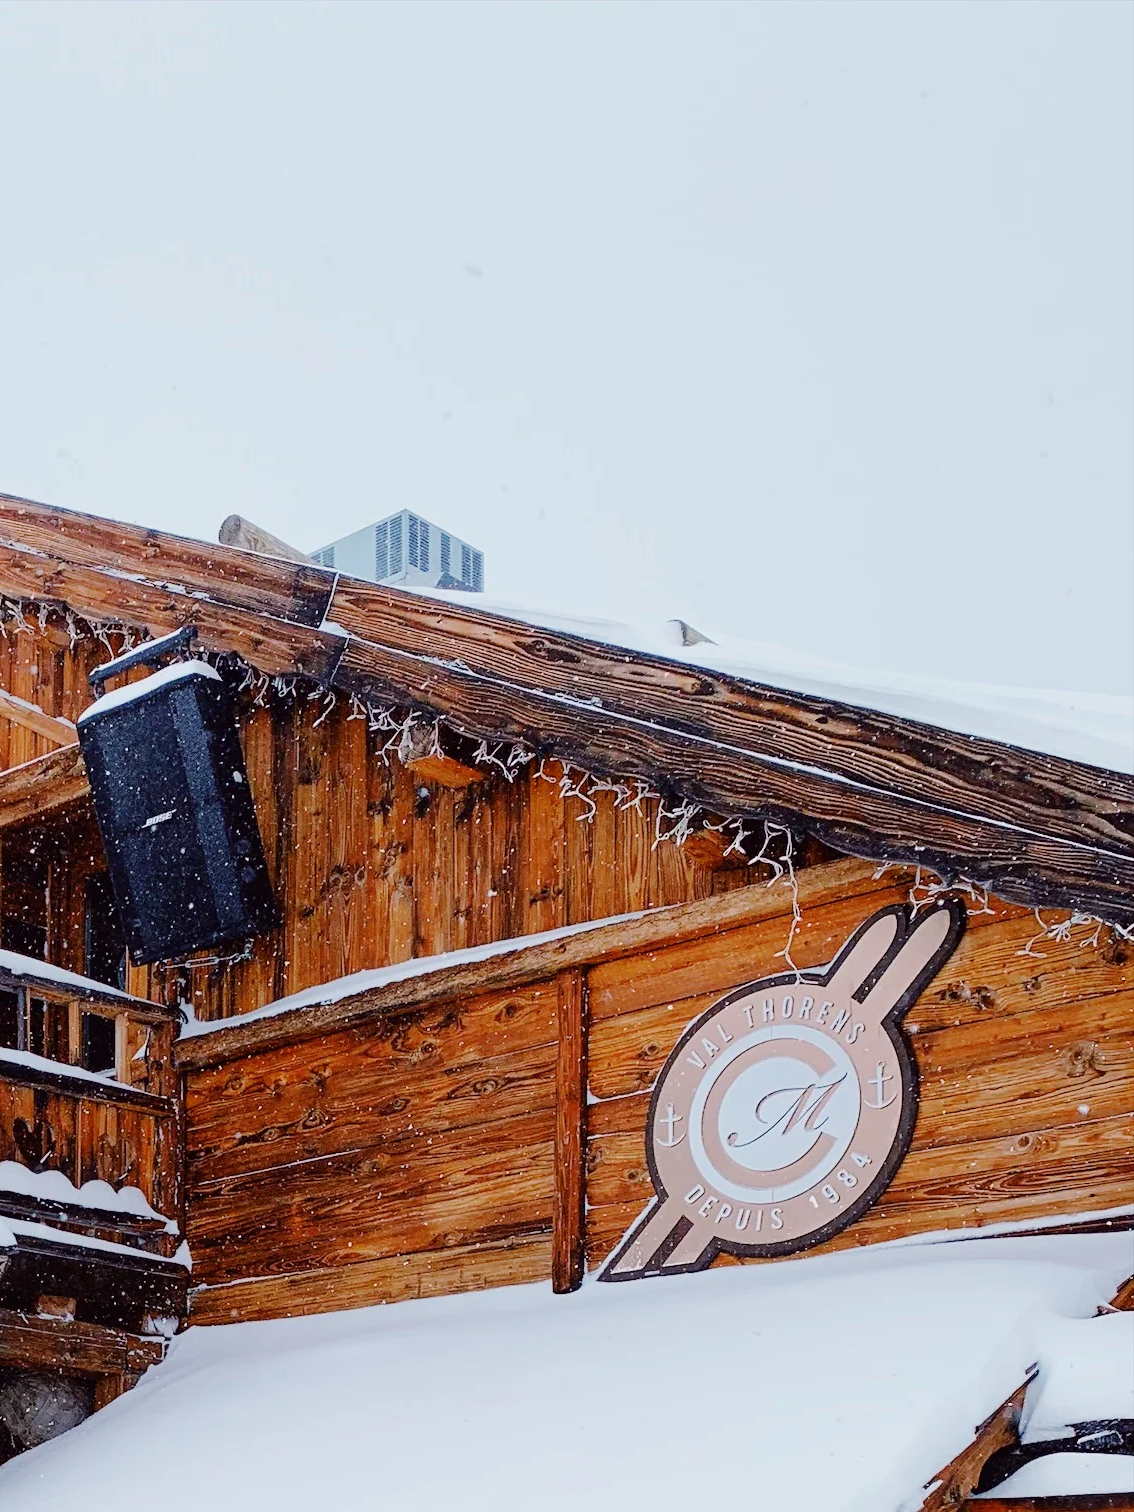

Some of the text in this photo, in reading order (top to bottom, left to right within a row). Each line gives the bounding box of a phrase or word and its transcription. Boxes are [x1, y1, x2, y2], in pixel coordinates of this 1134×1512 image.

[686, 995, 866, 1070] VAL THORENS
[683, 1150, 873, 1232] DEPUIS 1984
